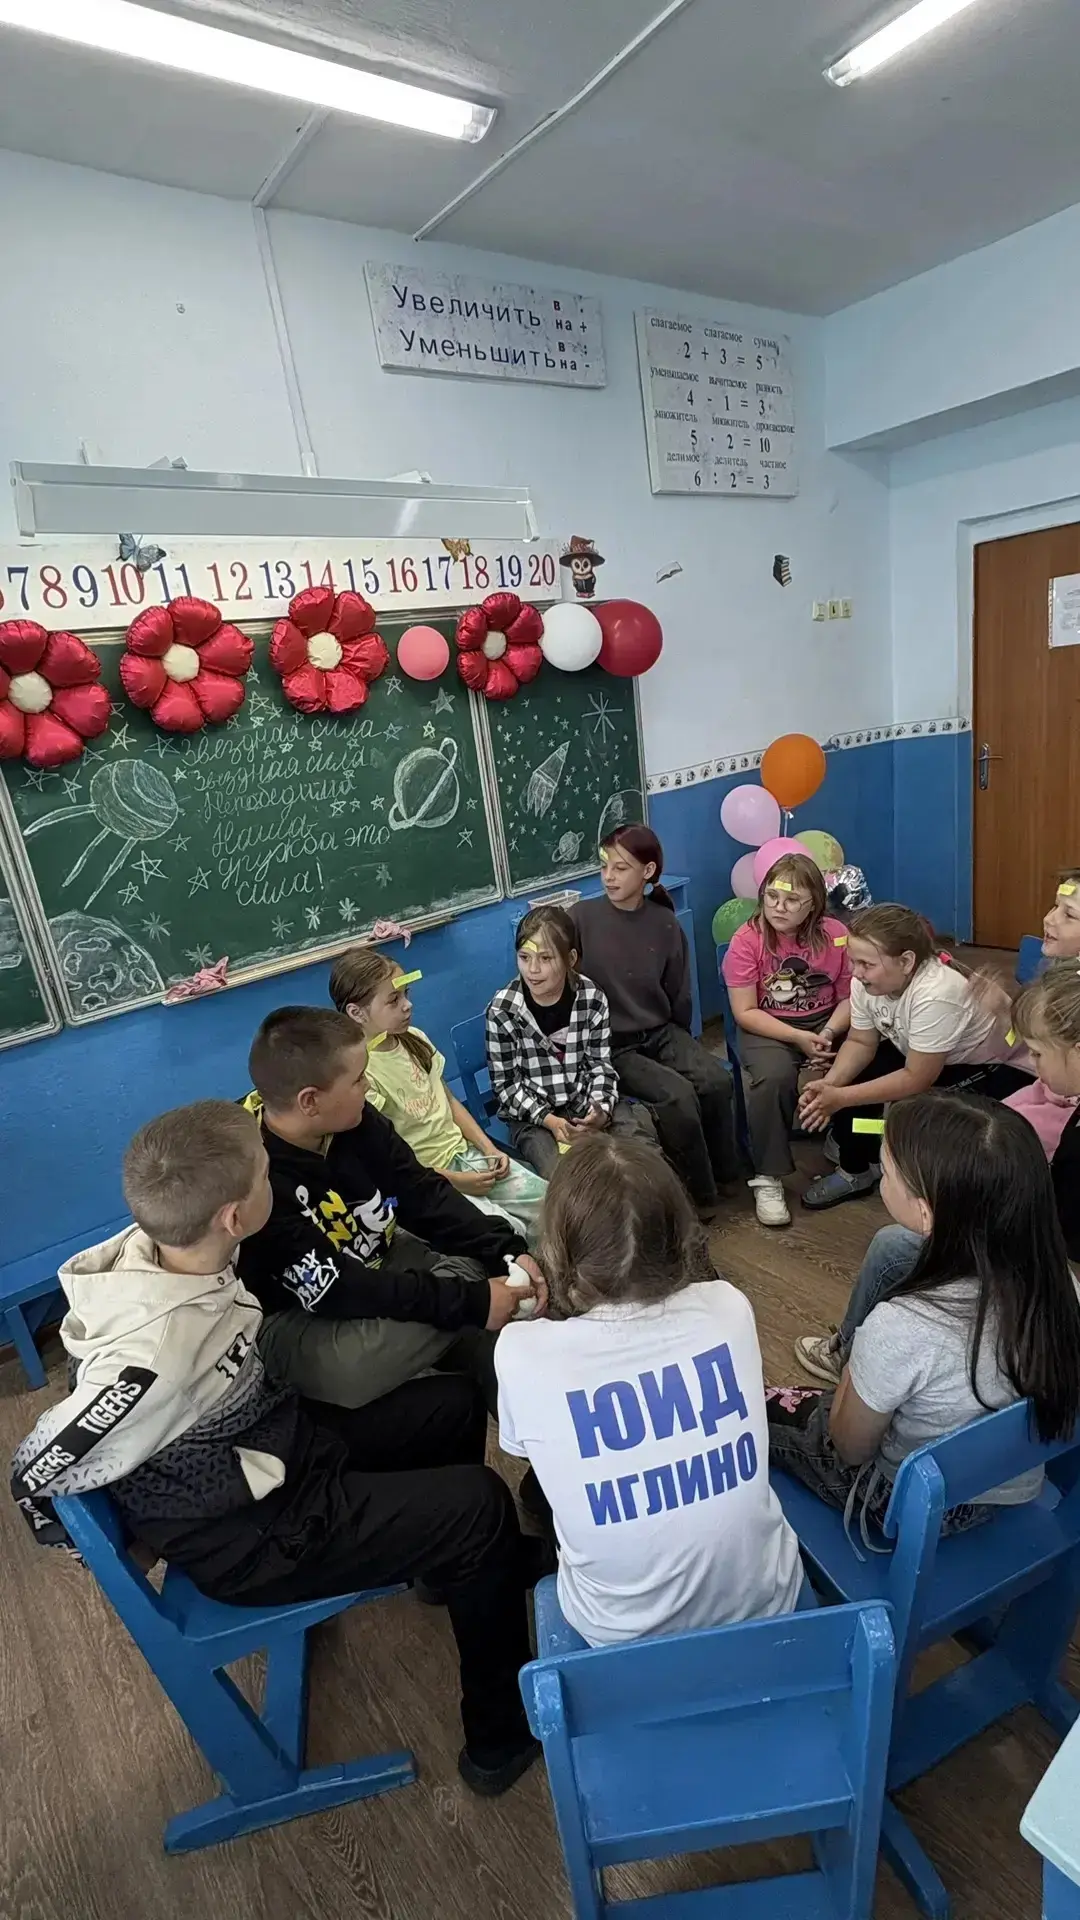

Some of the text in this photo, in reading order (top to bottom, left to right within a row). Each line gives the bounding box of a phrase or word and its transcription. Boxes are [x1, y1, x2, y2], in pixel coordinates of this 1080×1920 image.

[391, 284, 541, 327] Увеличить
[552, 300, 561, 311] в
[555, 318, 573, 331] на
[650, 317, 692, 333] слагаемое
[703, 327, 743, 343] слагаемое
[399, 328, 556, 369] Уменьшить
[558, 341, 566, 352] в
[683, 341, 763, 370] 2 + 3 = 5
[560, 359, 577, 371] на
[654, 409, 698, 423] множитель
[687, 389, 694, 406] 4
[724, 395, 730, 411] 1
[740, 399, 749, 407] =
[758, 399, 766, 416] 3
[690, 429, 698, 446] 5
[726, 433, 734, 449] 2
[743, 438, 751, 447] =
[759, 437, 770, 453] 10
[666, 452, 787, 470] делимое делитель частное
[694, 470, 701, 486] 6
[730, 472, 737, 488] 2
[746, 476, 754, 484] =
[763, 474, 770, 490] 3
[7, 565, 29, 611] 7
[39, 565, 68, 609] 8
[72, 564, 99, 608] 9
[101, 563, 145, 606] 10
[152, 562, 192, 603] 11
[207, 561, 253, 601] 12
[259, 560, 296, 599] 13
[301, 560, 338, 590] 14
[343, 557, 380, 595] 15
[386, 556, 418, 592] 16
[421, 556, 451, 591] 17
[459, 554, 490, 590] 18
[495, 554, 523, 588] 19
[528, 553, 555, 587] 20
[181, 722, 304, 767] Звездная
[212, 813, 312, 857] Наша
[344, 824, 391, 847] это
[77, 1380, 142, 1435] TIGERS
[565, 1342, 749, 1459] ЮИД
[22, 1444, 76, 1491] TIGERS
[584, 1431, 758, 1526] ИГЛИНО
